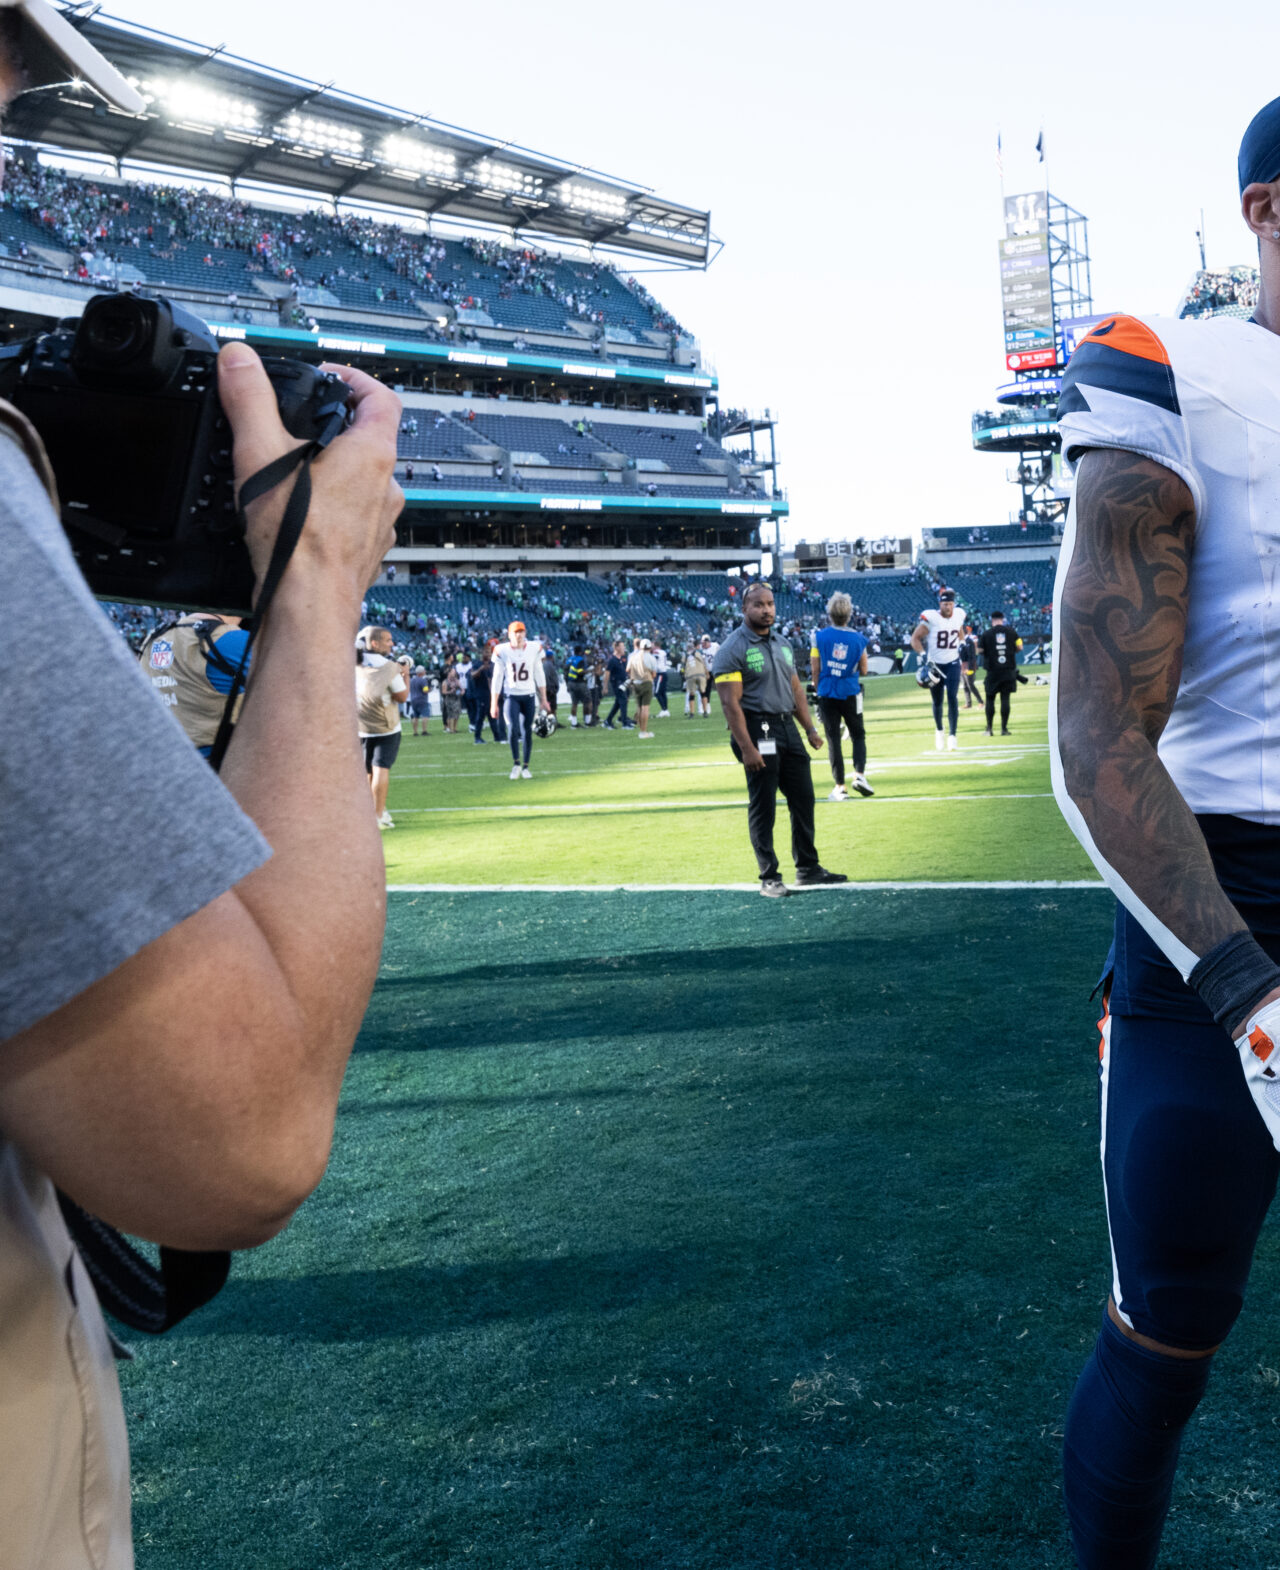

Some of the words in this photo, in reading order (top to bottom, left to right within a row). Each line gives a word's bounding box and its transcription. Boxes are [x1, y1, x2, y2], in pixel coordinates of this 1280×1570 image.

[1009, 424, 1036, 436] GAME
[937, 630, 960, 649] 82
[512, 662, 530, 683] 16
